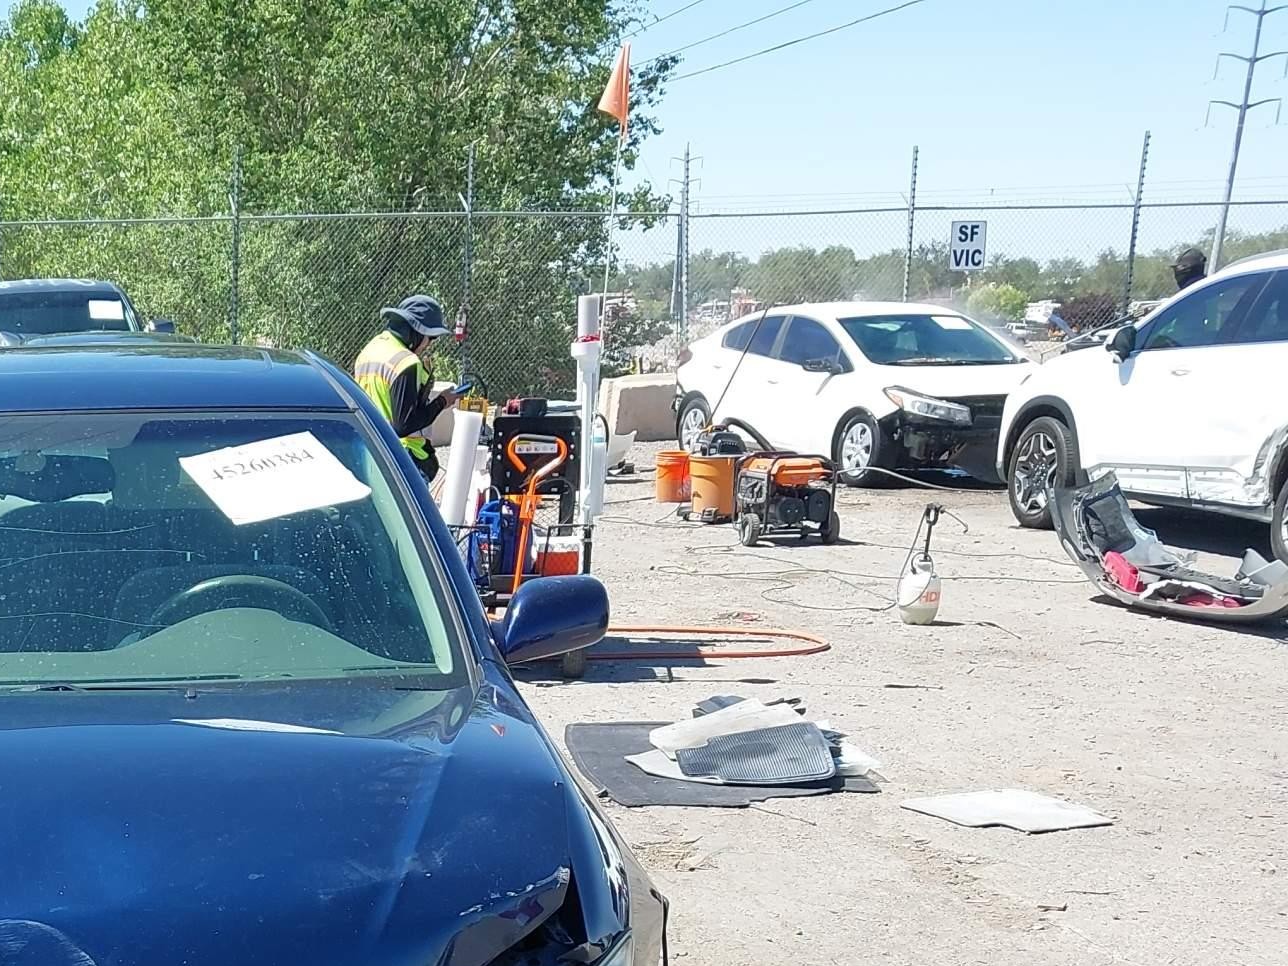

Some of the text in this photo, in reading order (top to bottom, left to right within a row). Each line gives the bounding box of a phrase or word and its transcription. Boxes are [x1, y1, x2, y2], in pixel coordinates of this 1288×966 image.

[958, 224, 980, 243] SF
[952, 248, 982, 267] VIC
[211, 448, 315, 481] 45260384
